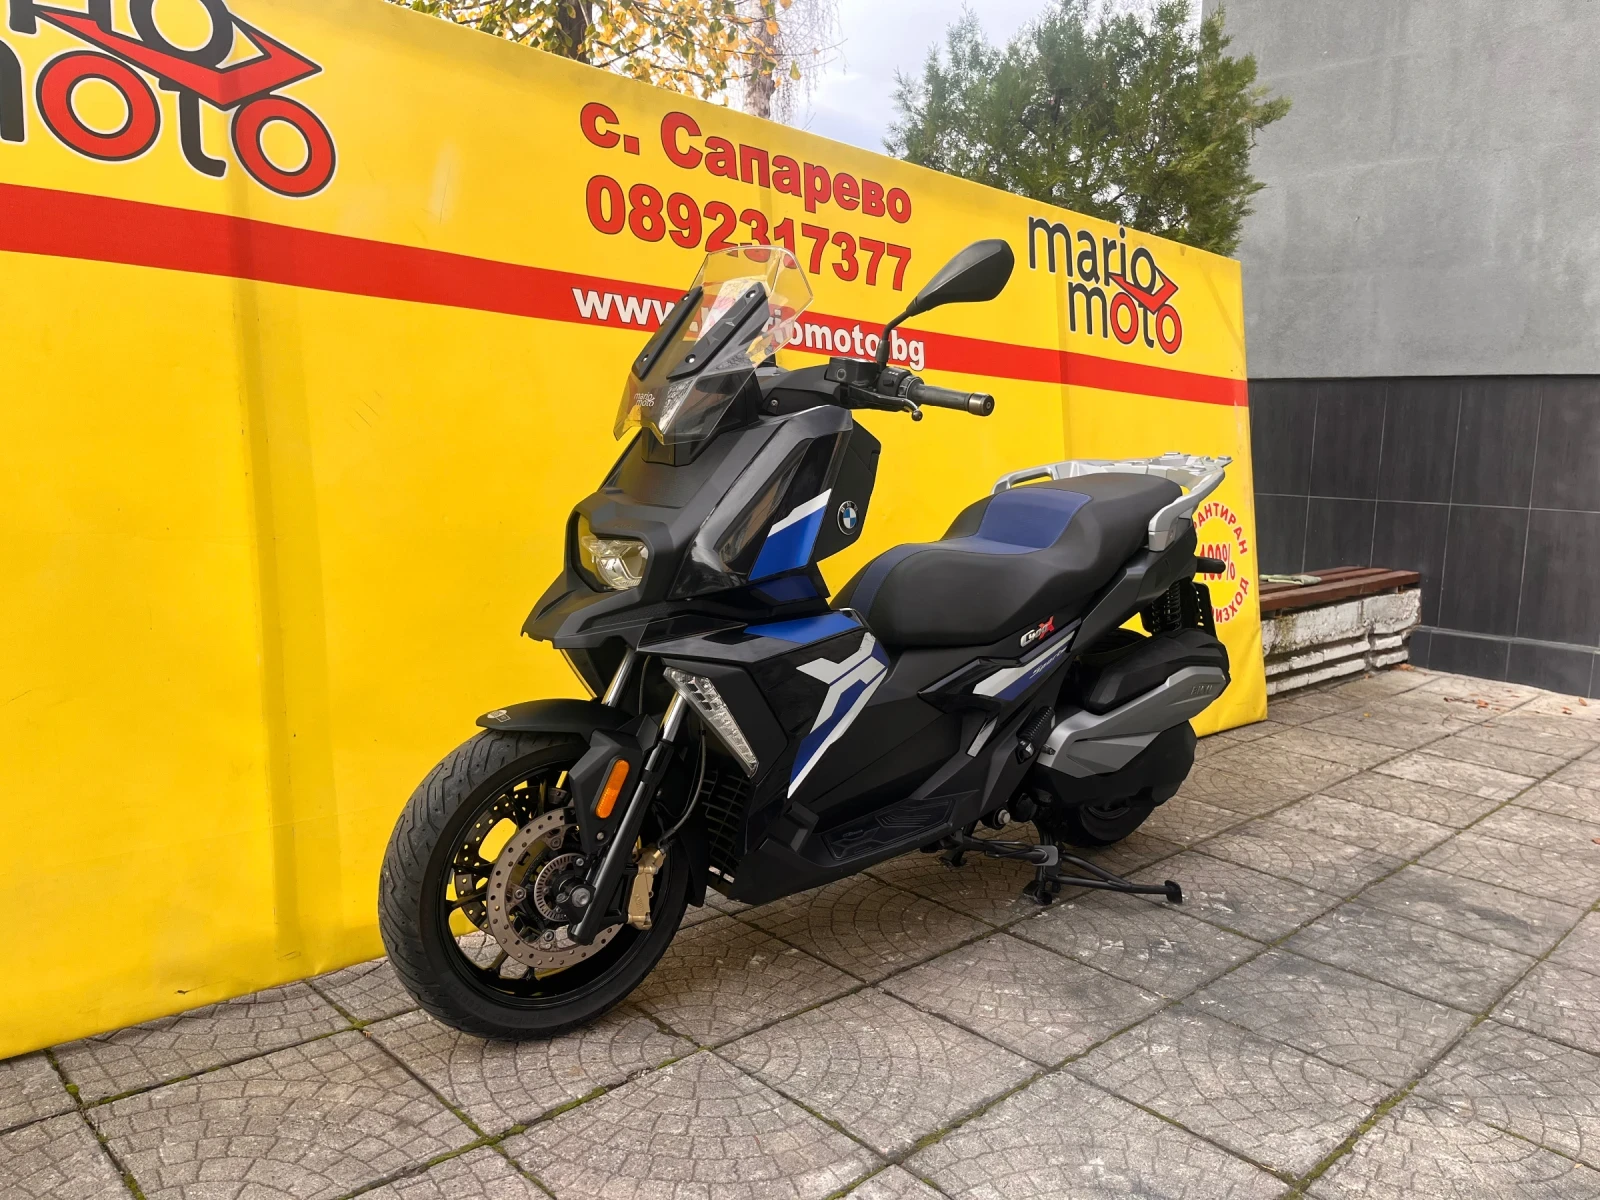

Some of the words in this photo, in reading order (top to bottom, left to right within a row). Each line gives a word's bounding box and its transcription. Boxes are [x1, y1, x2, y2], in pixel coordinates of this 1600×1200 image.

[0, 40, 336, 198] oto
[660, 110, 912, 224] Сапарево
[585, 174, 912, 292] 0892317377
[1028, 216, 1157, 295] mario
[1068, 281, 1182, 354] moto
[1193, 502, 1248, 555] АНТИРАН
[1211, 577, 1250, 623] ИЗХОД
